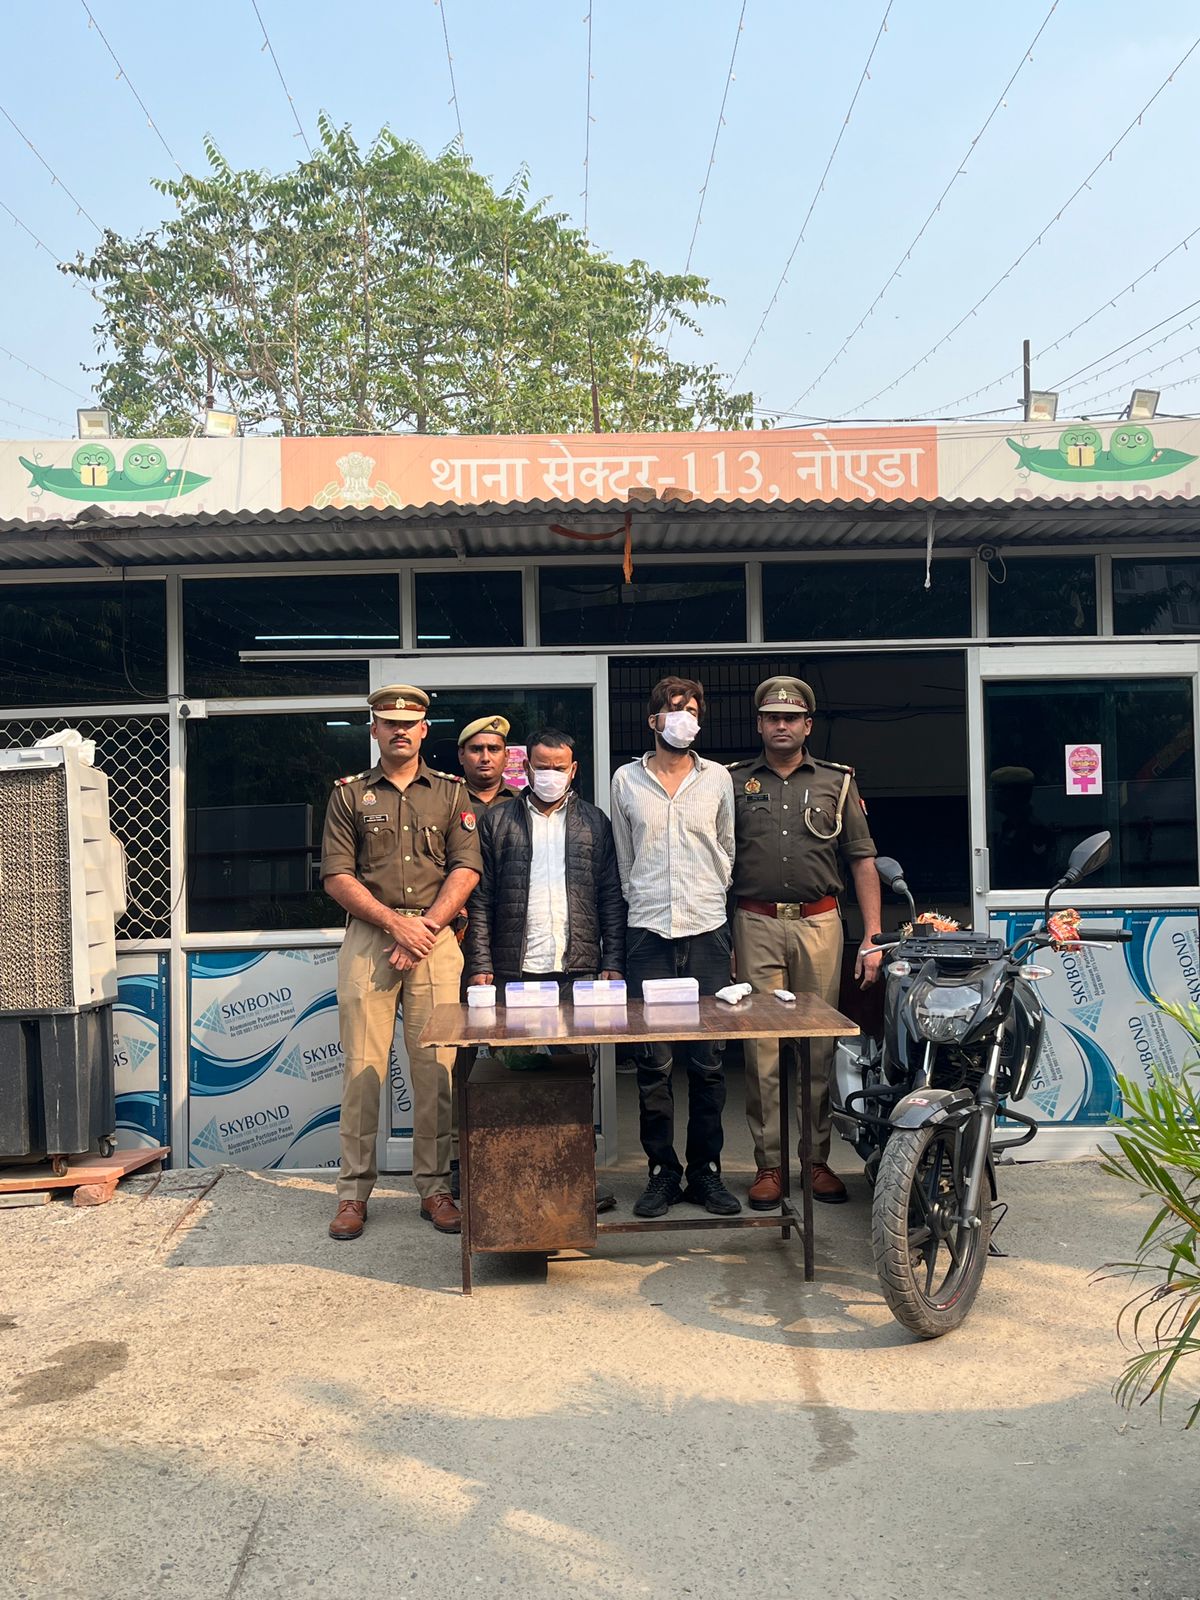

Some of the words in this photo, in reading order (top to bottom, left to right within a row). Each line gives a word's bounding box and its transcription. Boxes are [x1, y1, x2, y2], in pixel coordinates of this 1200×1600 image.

[430, 458, 530, 498] थाना
[791, 432, 925, 497] नोएडा
[1171, 932, 1200, 1003] SKYBOND
[221, 987, 292, 1019] SKYBOND
[390, 1044, 412, 1112] YBOND
[220, 1104, 290, 1137] SKYBOND
